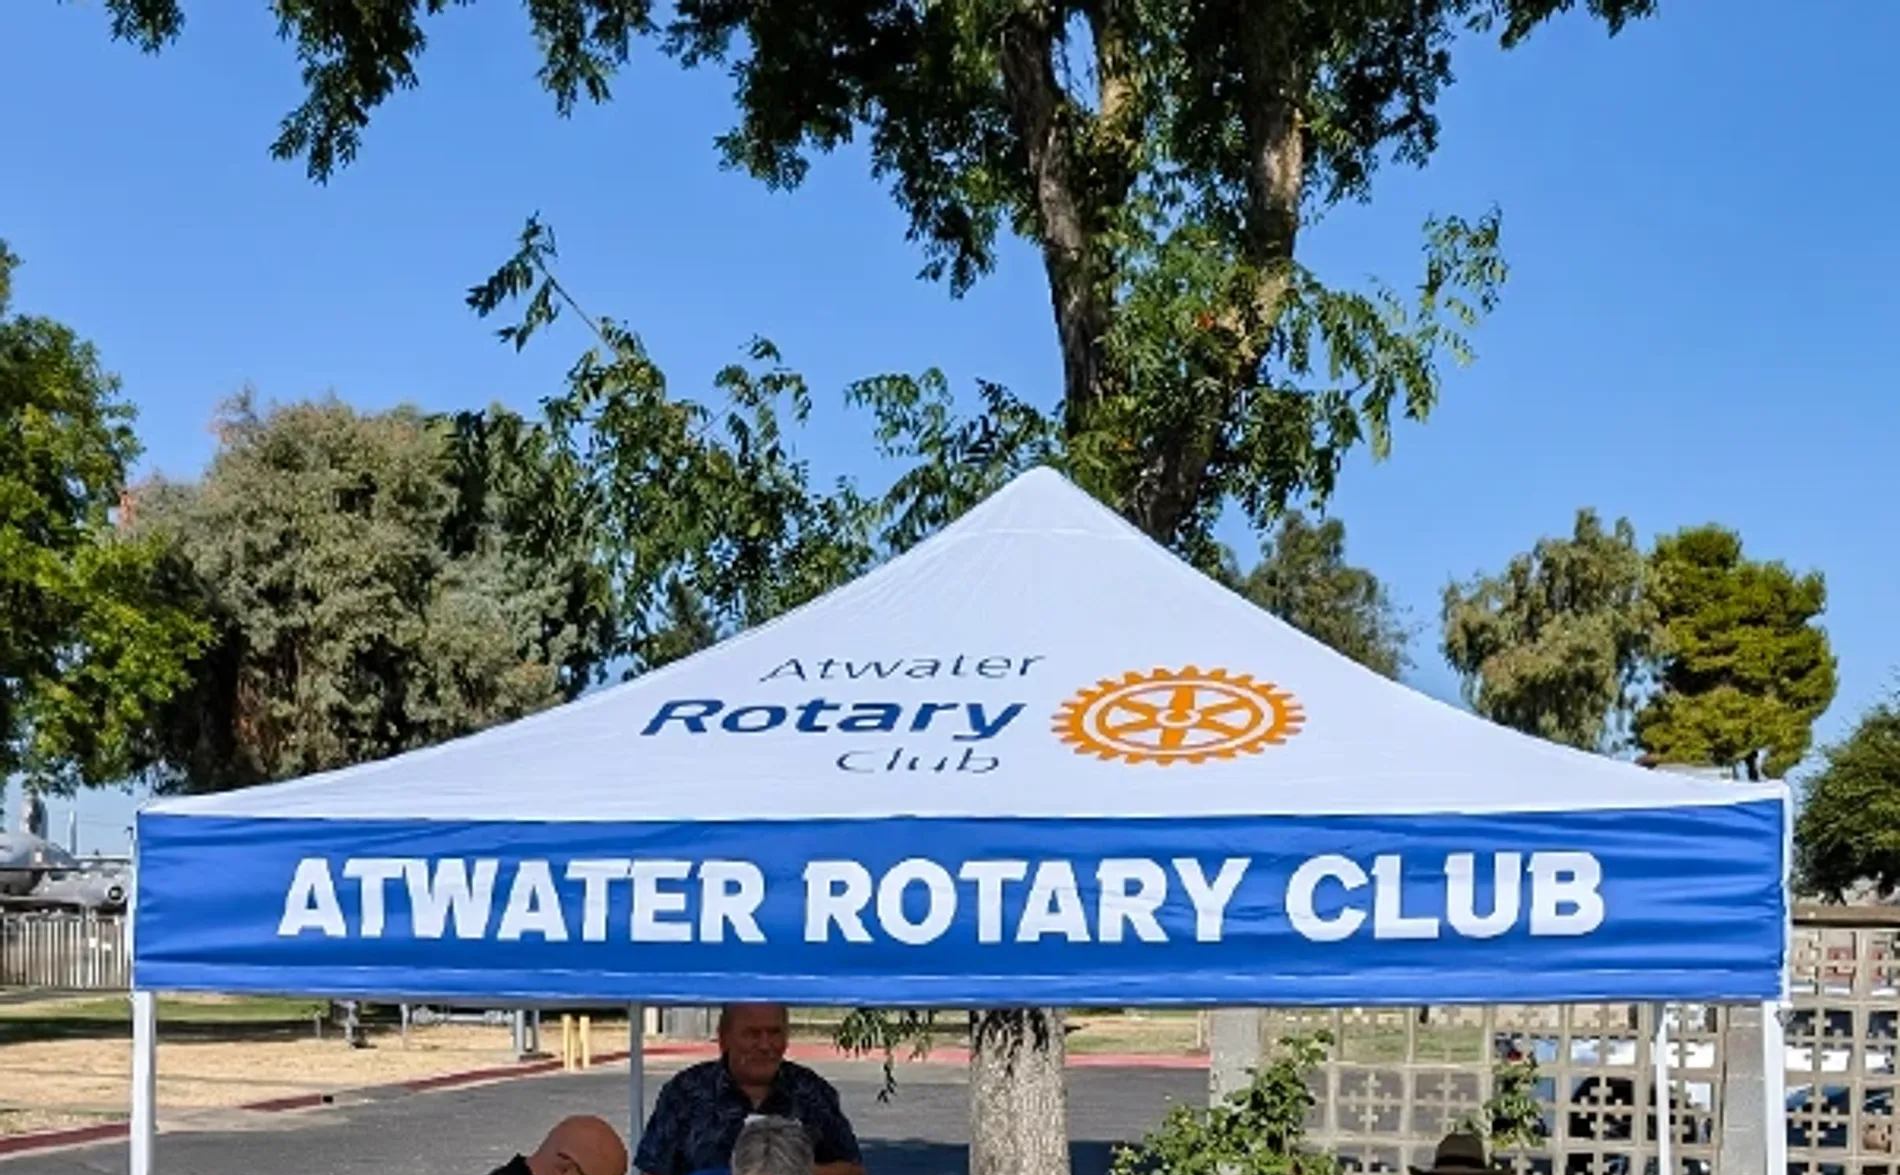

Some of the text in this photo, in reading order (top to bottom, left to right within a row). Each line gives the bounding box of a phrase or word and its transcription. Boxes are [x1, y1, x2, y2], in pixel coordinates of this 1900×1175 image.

[759, 654, 1045, 682] Atwater
[639, 697, 1027, 741] Rotary
[836, 747, 1000, 774] Club
[278, 851, 1605, 944] ATWATER ROTARY CLUB
